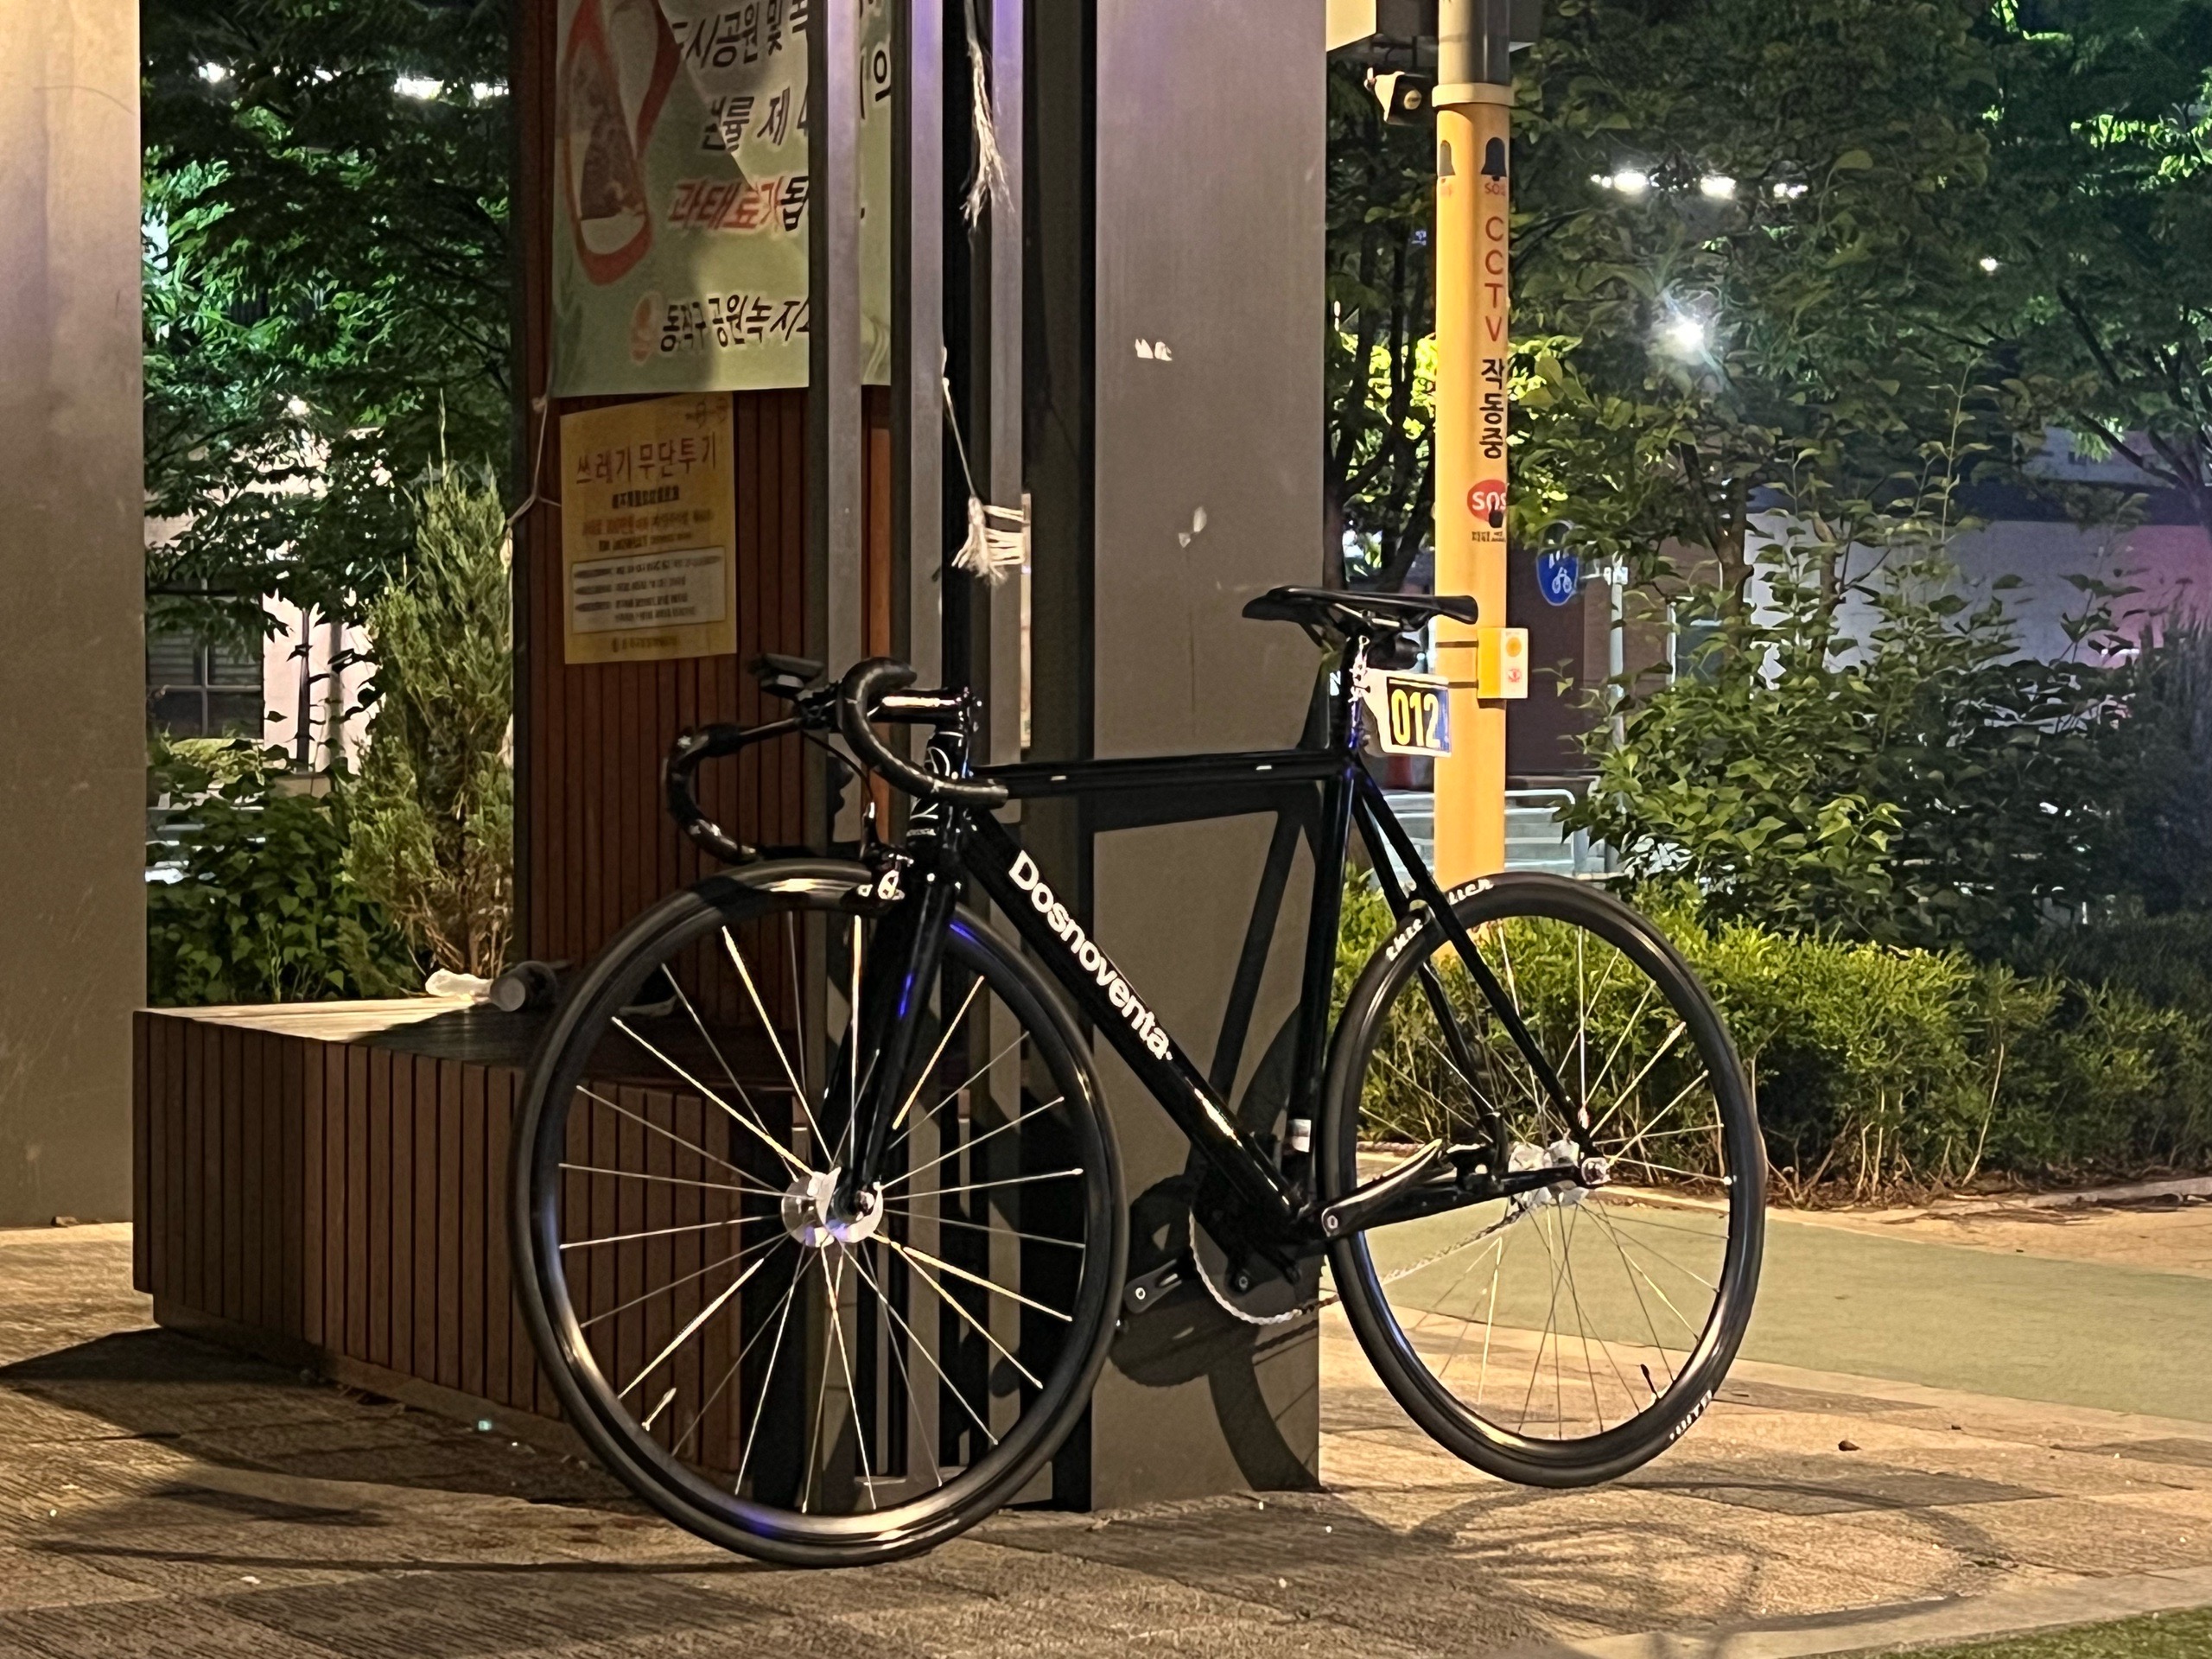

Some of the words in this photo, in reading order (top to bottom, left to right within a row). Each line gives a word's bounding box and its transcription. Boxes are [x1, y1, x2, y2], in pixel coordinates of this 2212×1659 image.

[1484, 215, 1504, 342] CCTV
[1478, 358, 1505, 460] 작동중
[576, 444, 632, 485] 쓰레기
[1471, 491, 1507, 512] SOS
[1391, 688, 1441, 749] 012
